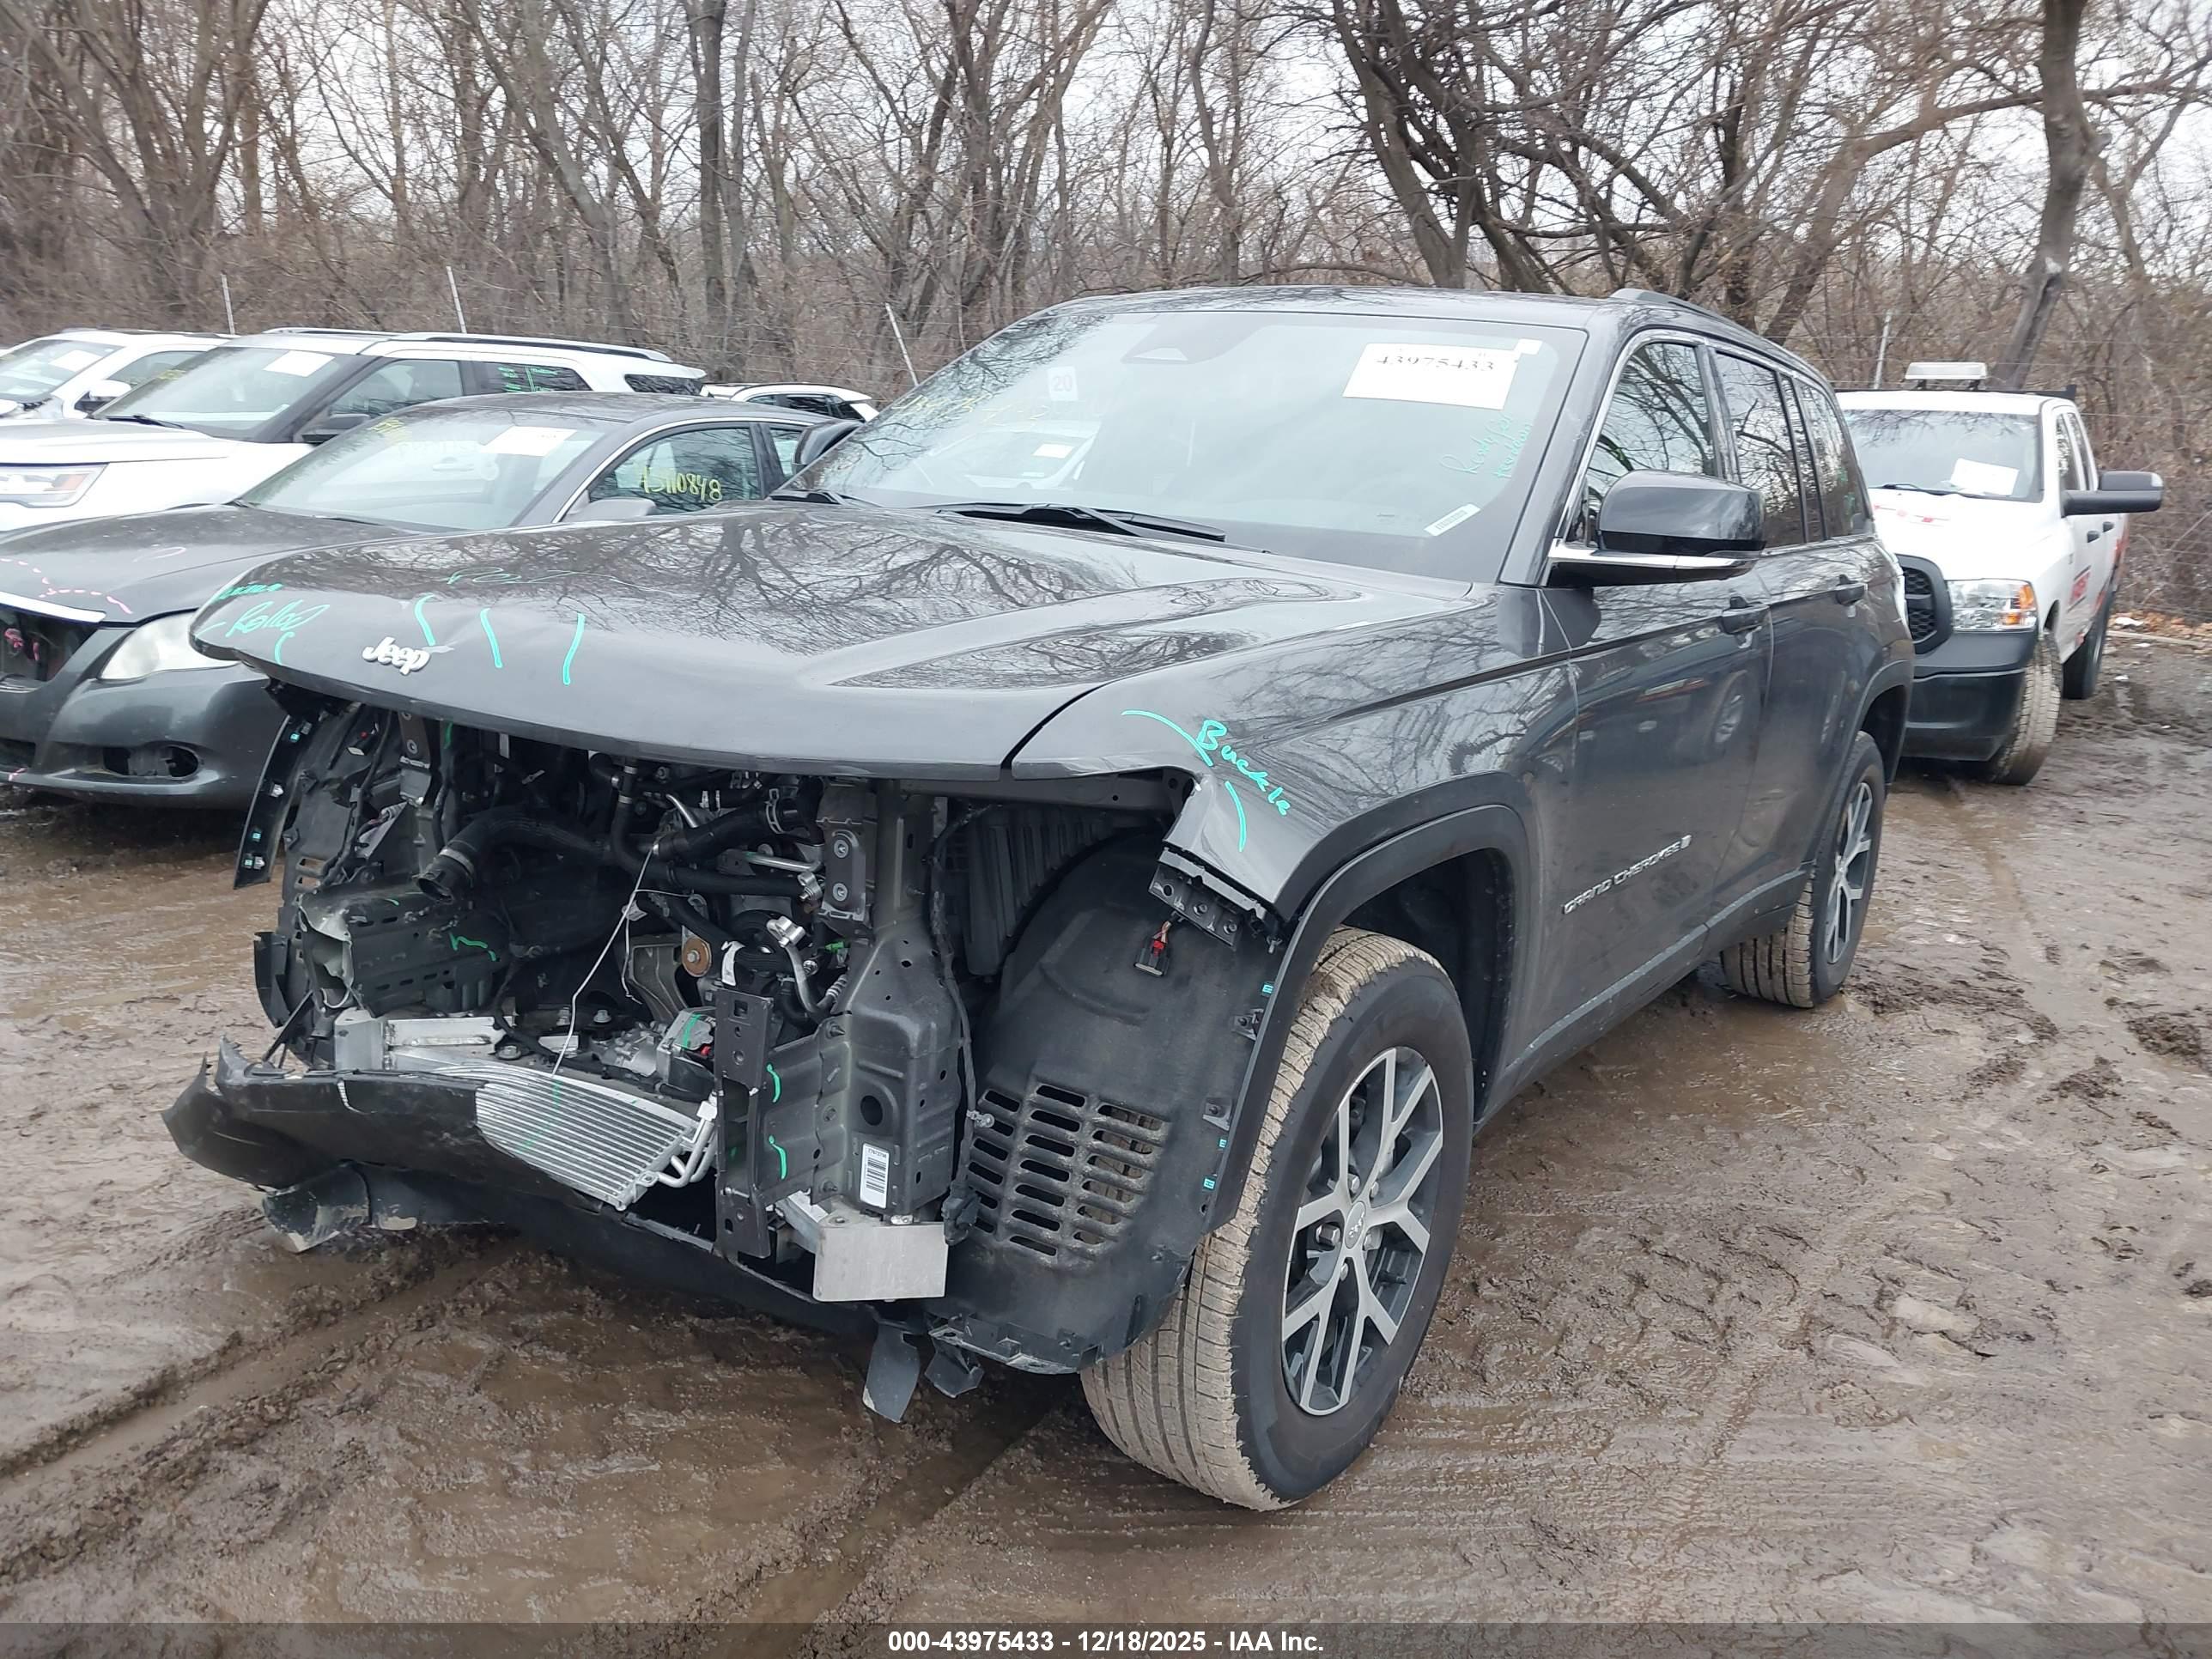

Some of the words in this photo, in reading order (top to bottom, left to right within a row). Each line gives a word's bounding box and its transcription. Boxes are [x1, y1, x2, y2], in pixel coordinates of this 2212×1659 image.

[1376, 355, 1494, 371] 43975433
[362, 635, 431, 676] Jeep
[1196, 720, 1291, 815] Buckle
[1563, 878, 1613, 915] GRAND
[1613, 841, 1681, 885] CHEROKEE
